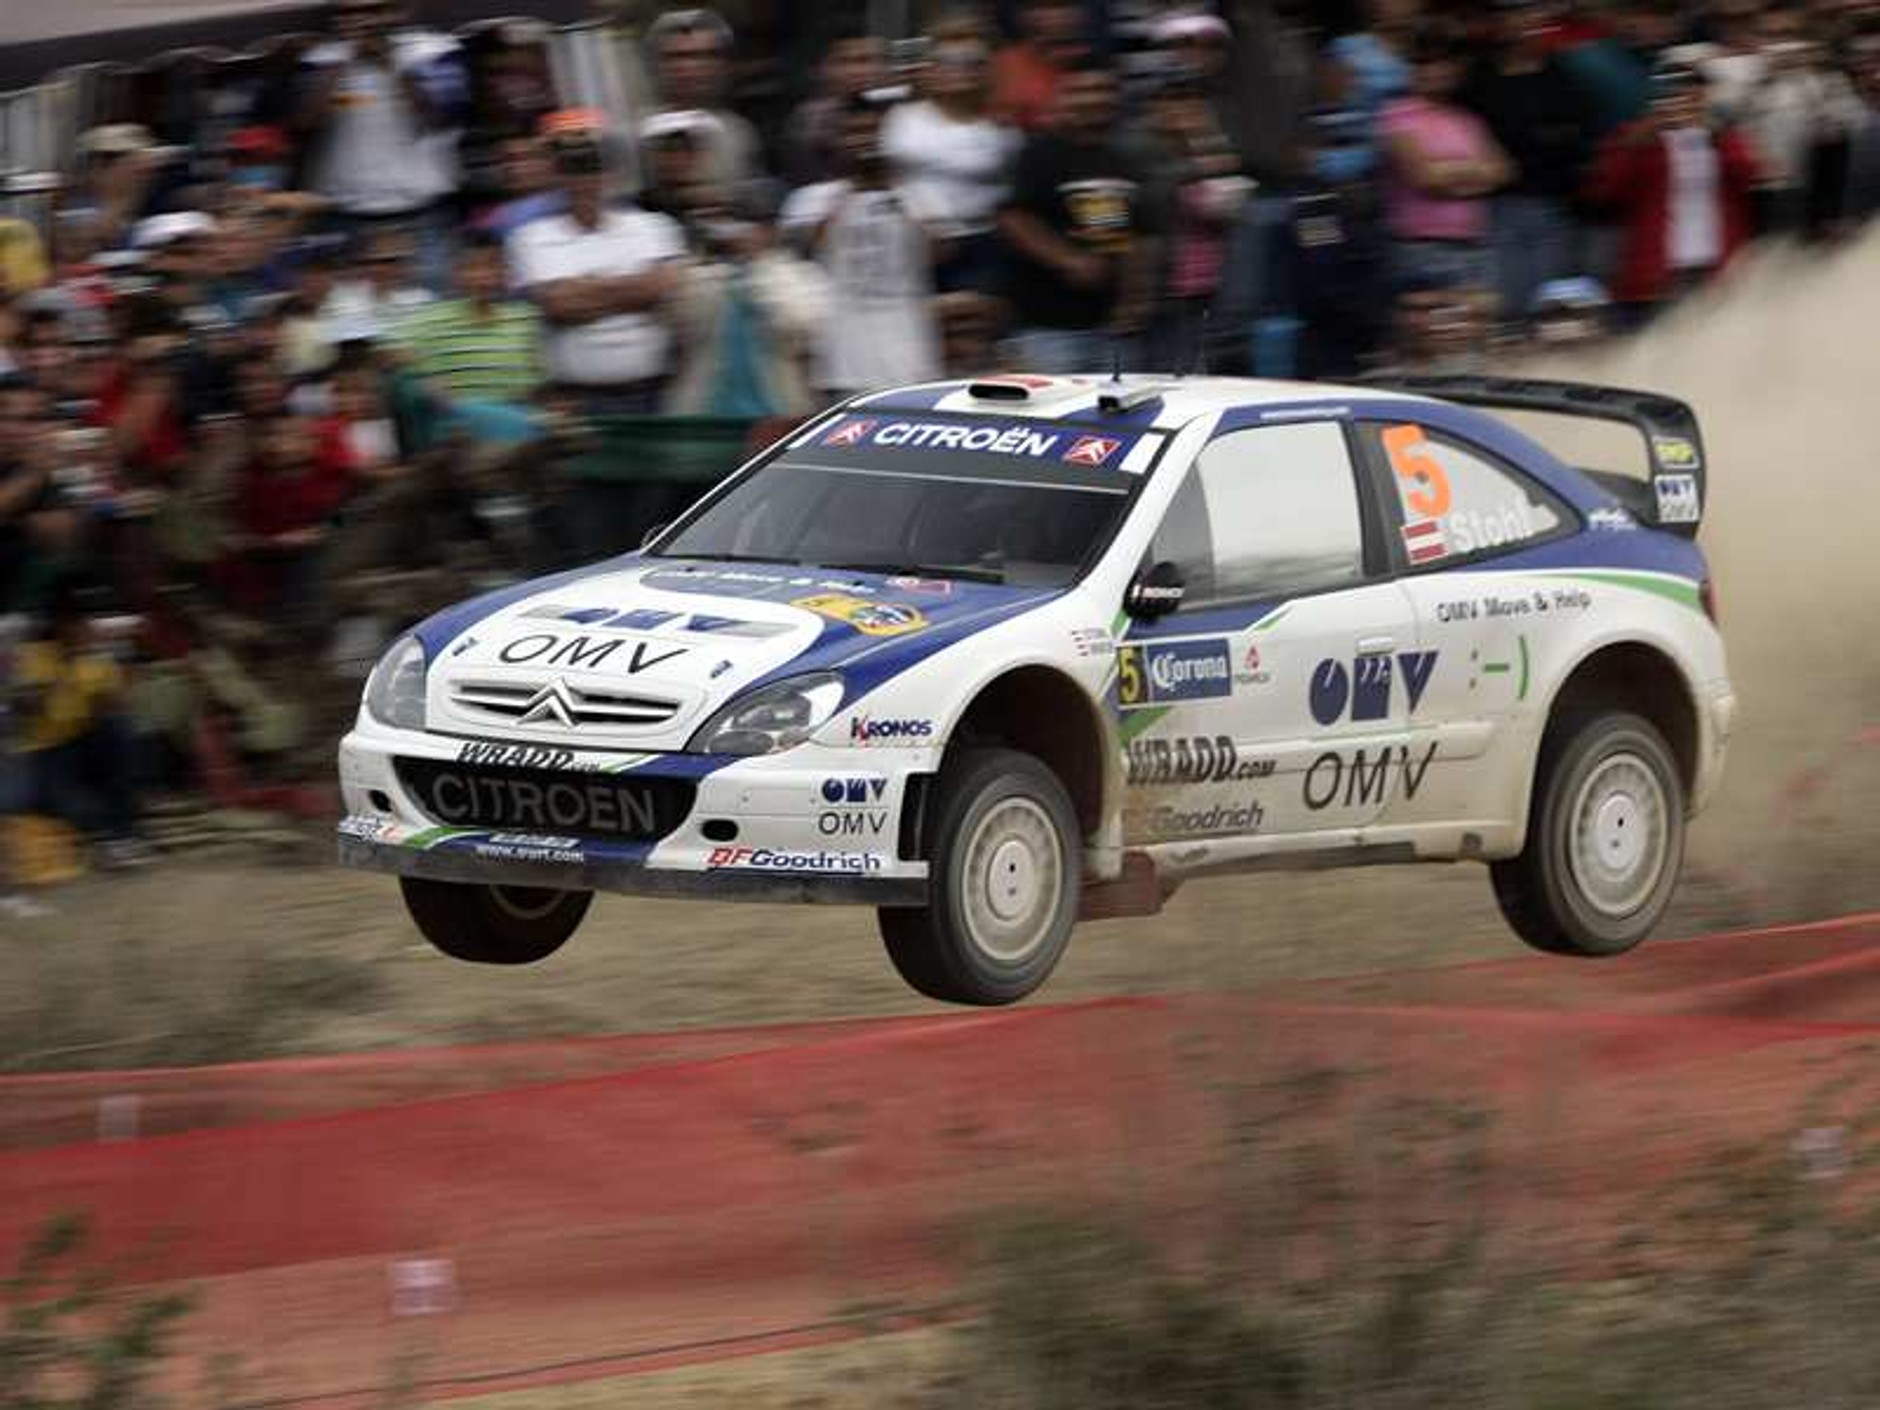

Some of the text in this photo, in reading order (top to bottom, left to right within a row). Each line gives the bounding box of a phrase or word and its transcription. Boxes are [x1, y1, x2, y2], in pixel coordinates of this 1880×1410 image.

[873, 424, 1057, 456] CITROËN
[1382, 423, 1451, 518] 5
[499, 633, 690, 674] OMV
[1118, 648, 1228, 703] 5 Corona
[851, 715, 933, 741] KRONOS
[1304, 741, 1438, 811] OMV
[818, 811, 888, 836] OMV
[707, 847, 881, 871] BFGoodrich
